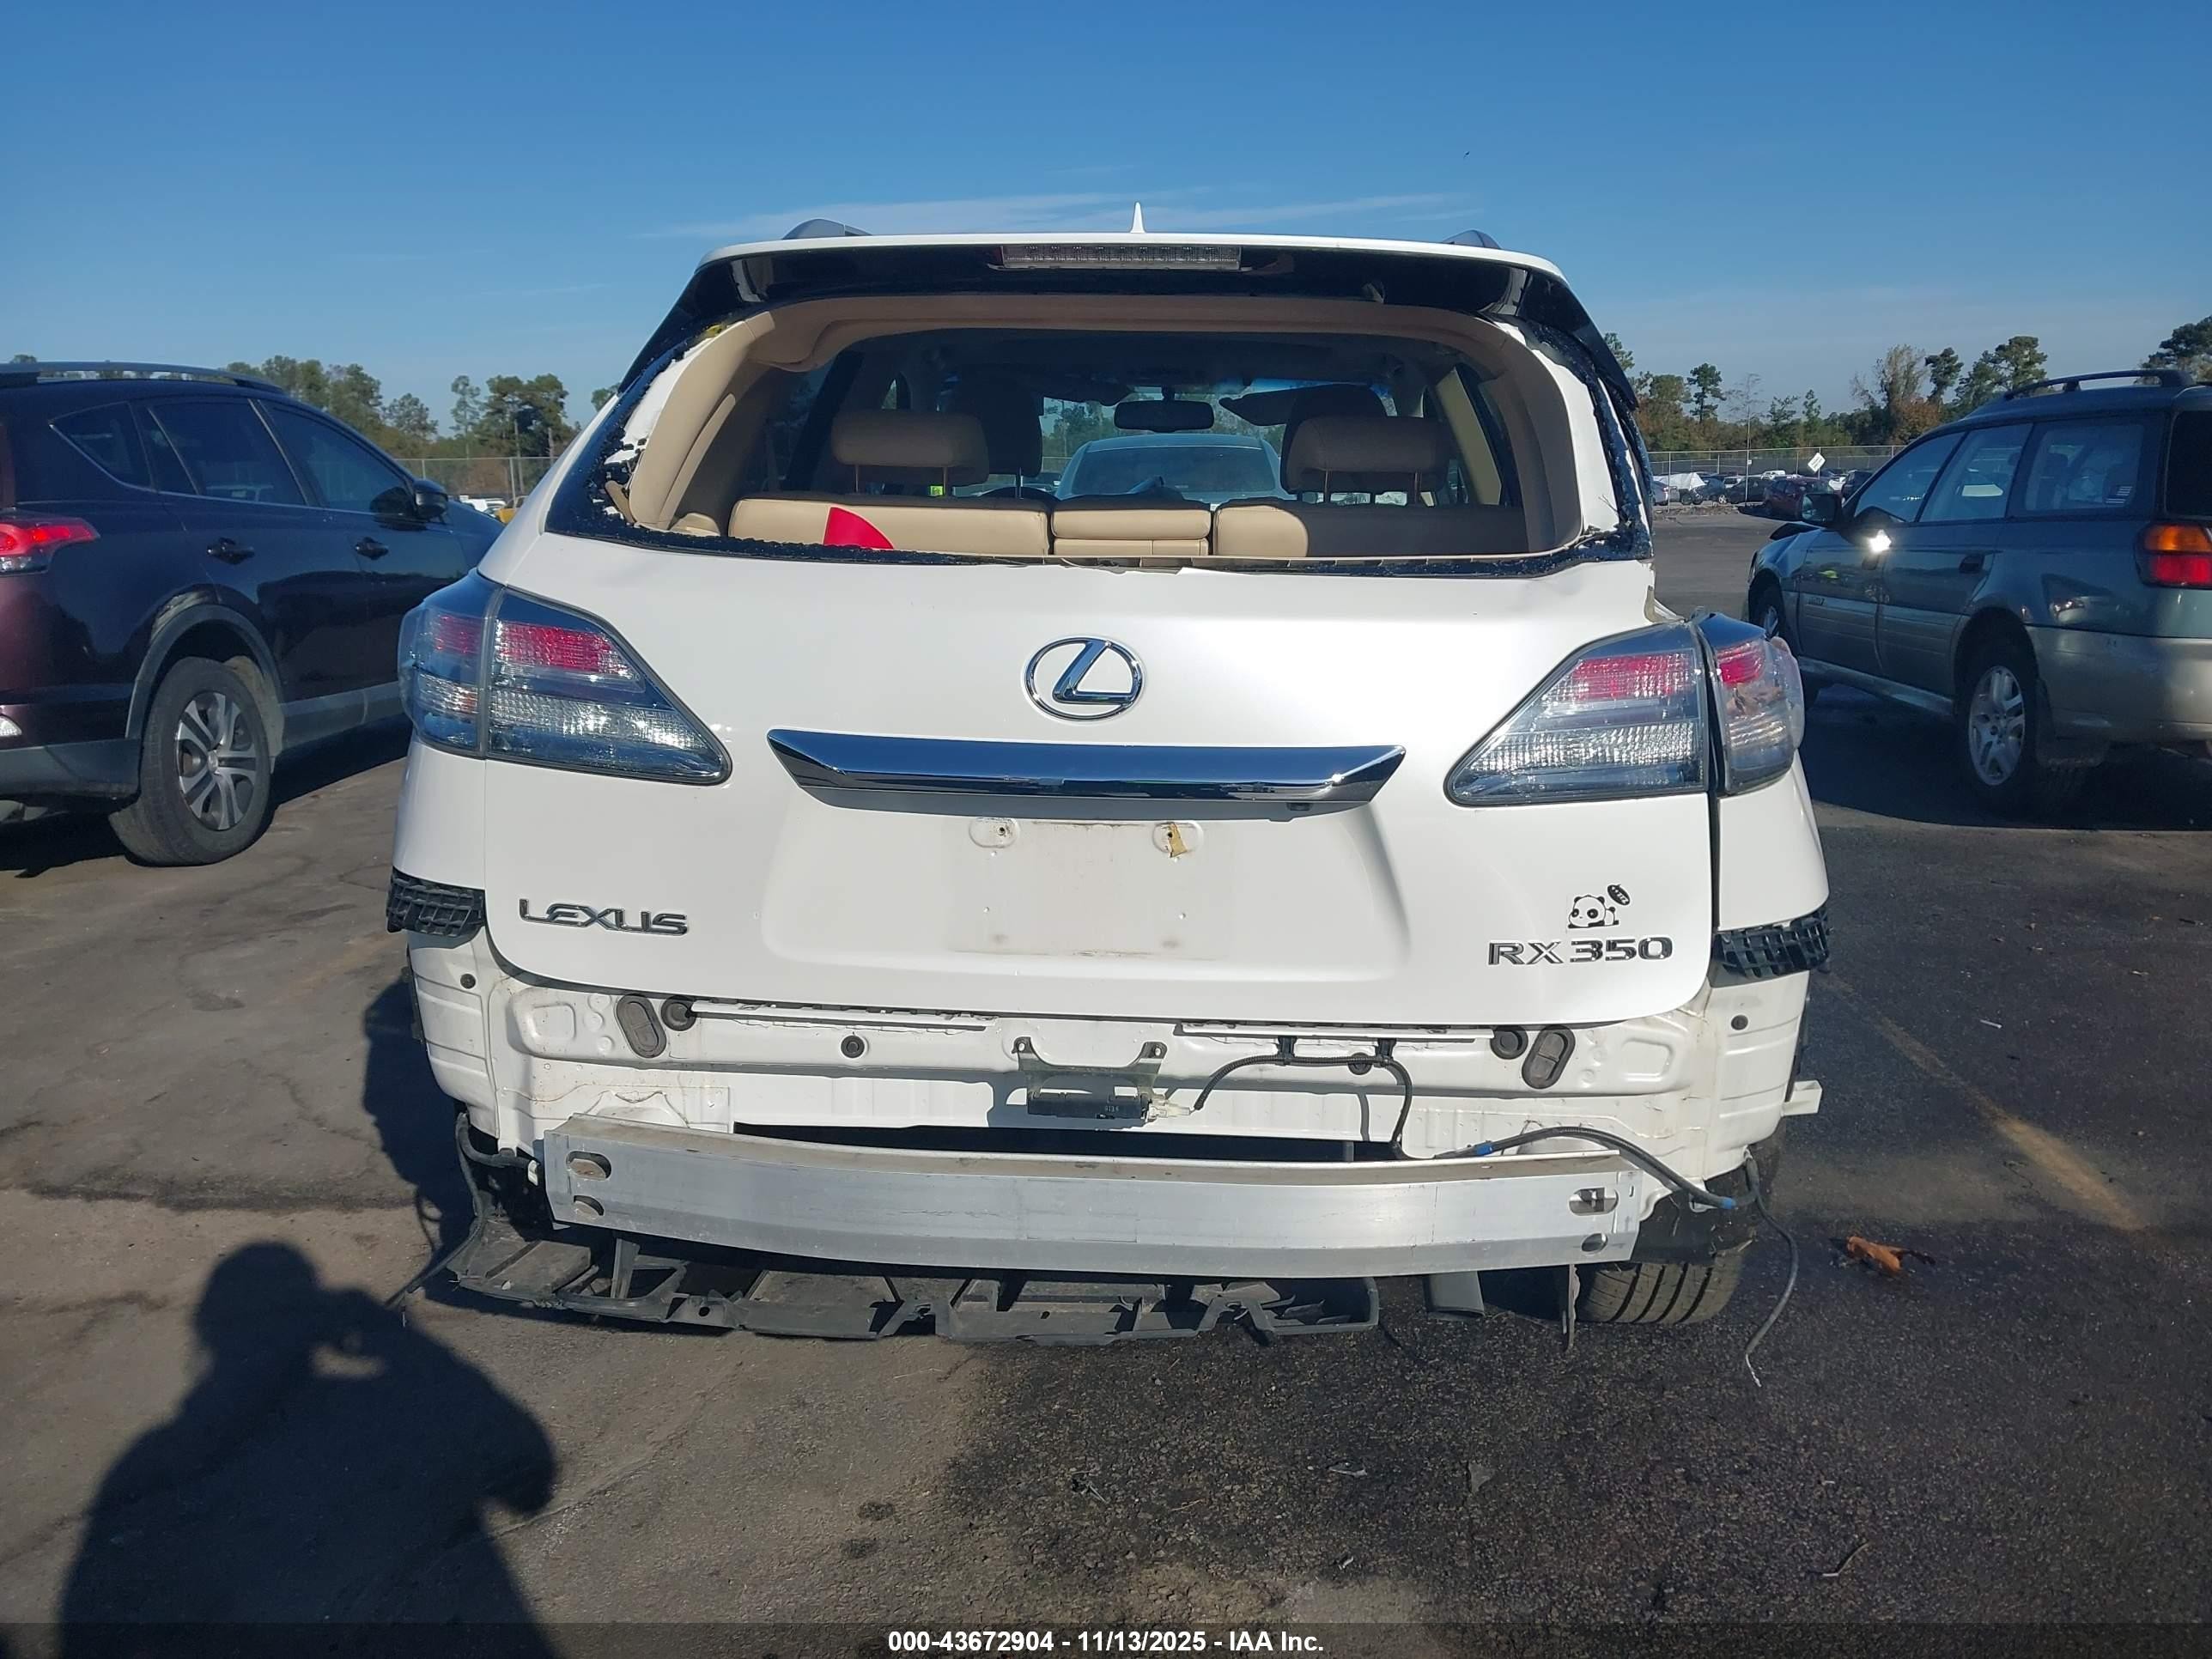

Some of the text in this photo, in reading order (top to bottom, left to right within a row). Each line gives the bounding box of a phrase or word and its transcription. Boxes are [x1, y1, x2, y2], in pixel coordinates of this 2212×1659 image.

[519, 898, 688, 936] LEXUS
[1487, 936, 1674, 965] RX 350
